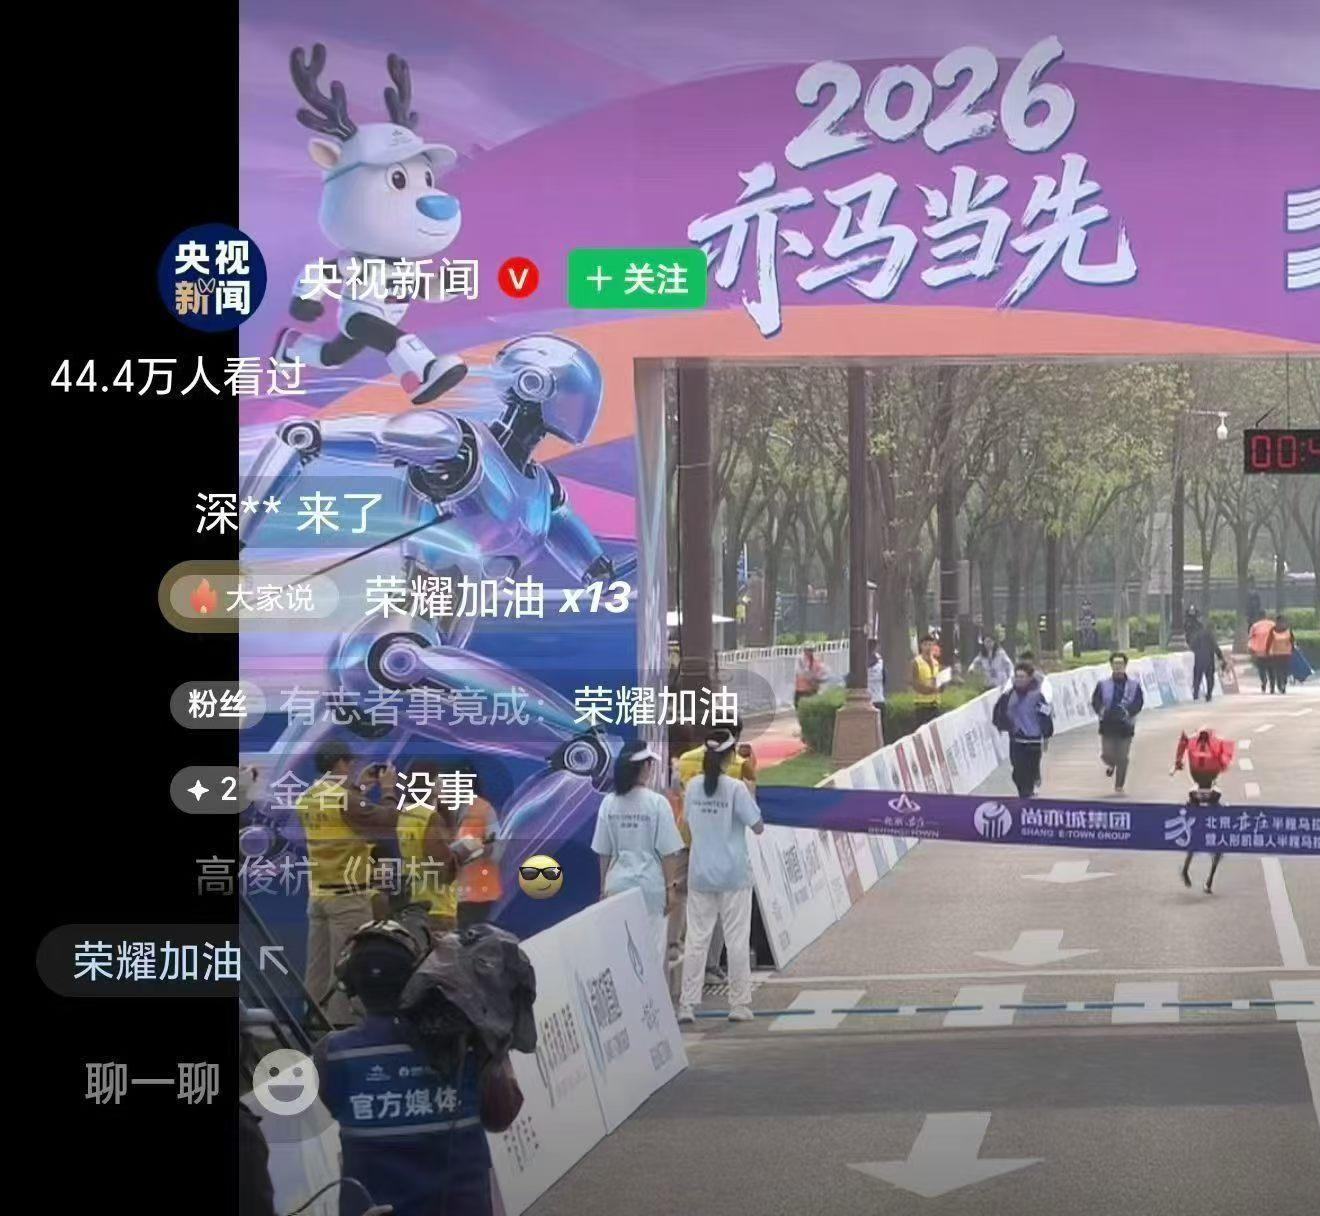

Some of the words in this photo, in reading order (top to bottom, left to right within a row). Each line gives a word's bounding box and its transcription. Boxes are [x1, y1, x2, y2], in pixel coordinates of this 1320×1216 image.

[785, 34, 1075, 168] 2026
[688, 153, 1138, 337] 亦马当先
[1021, 807, 1131, 830] 尚亦城集团
[1098, 832, 1131, 841] GROUP
[349, 1086, 459, 1120] 官方媒体
